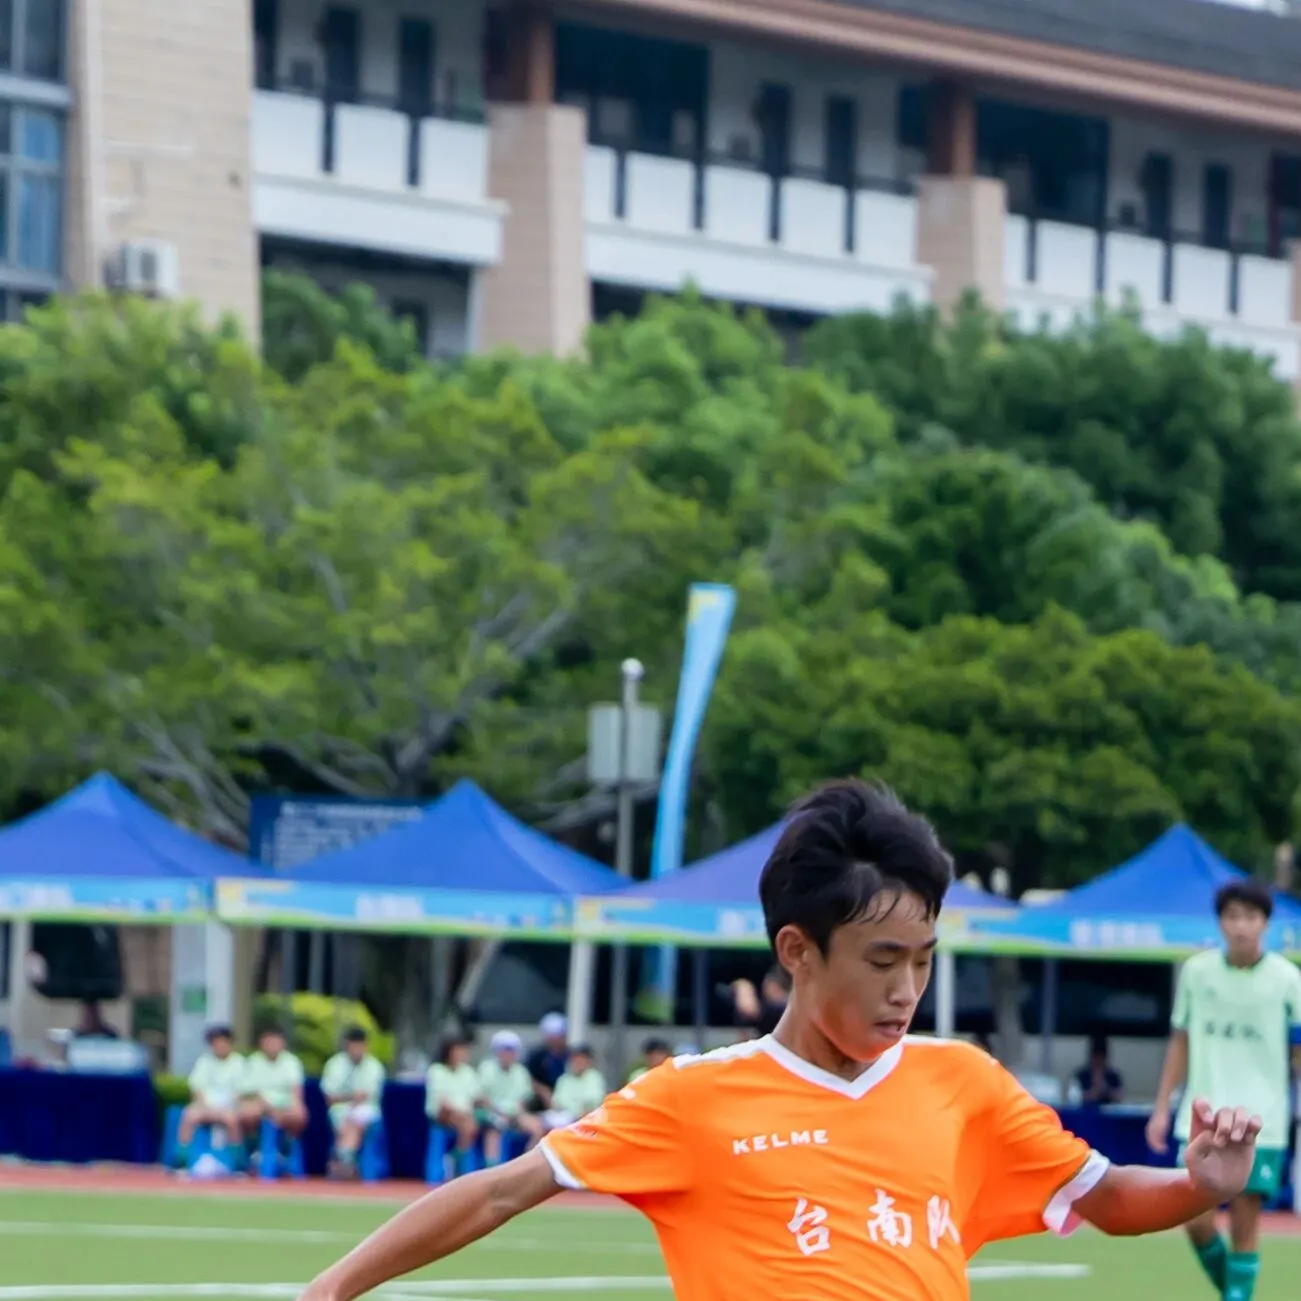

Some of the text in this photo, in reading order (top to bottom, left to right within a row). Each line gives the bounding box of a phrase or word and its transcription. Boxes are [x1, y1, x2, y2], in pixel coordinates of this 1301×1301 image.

[732, 1128, 829, 1155] KELME
[786, 1188, 961, 1256] 台南队
